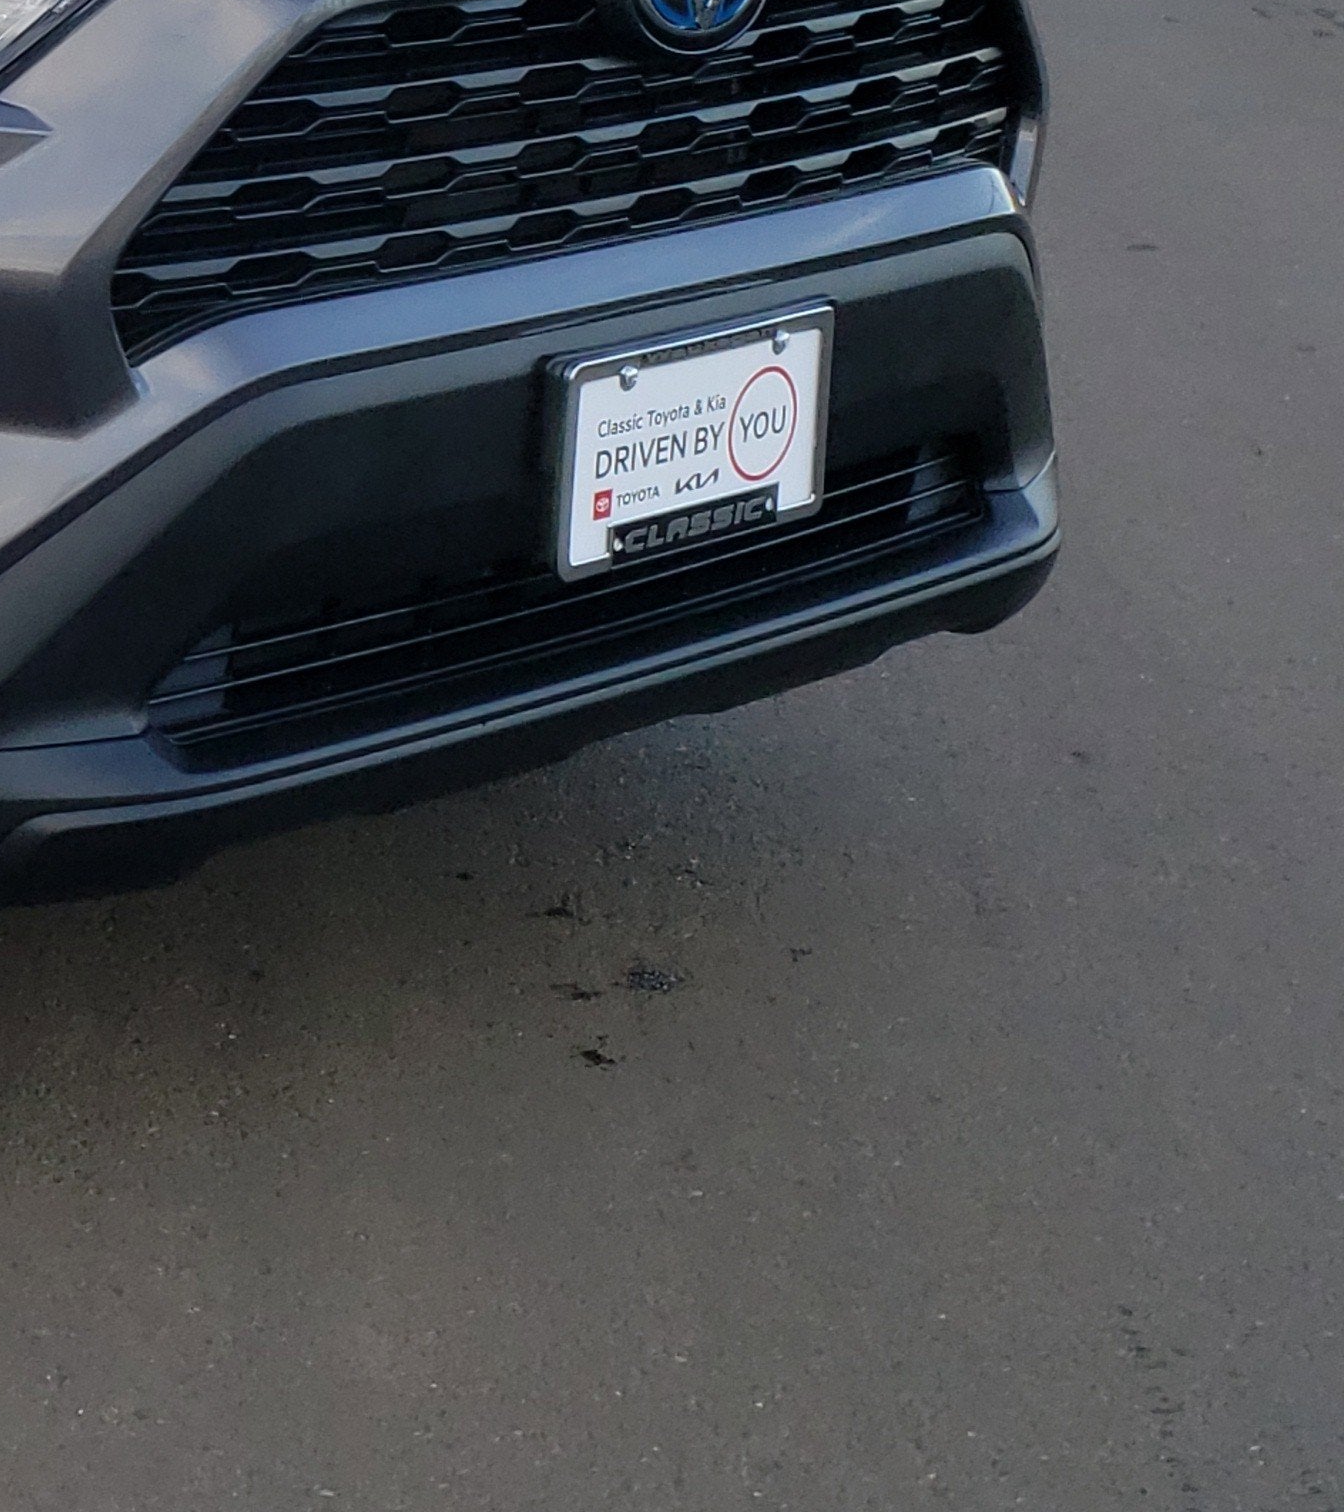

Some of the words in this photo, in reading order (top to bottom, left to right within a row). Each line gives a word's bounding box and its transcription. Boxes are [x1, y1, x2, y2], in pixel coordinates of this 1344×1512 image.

[597, 413, 643, 438] Classic
[647, 404, 690, 427] Toyota
[694, 398, 703, 416] &
[707, 394, 727, 412] Kia
[595, 430, 688, 479] DRIVEN
[694, 421, 725, 455] BY
[740, 405, 787, 442] YOU
[616, 485, 660, 508] TOYOTA
[624, 495, 766, 554] CLASSIC
